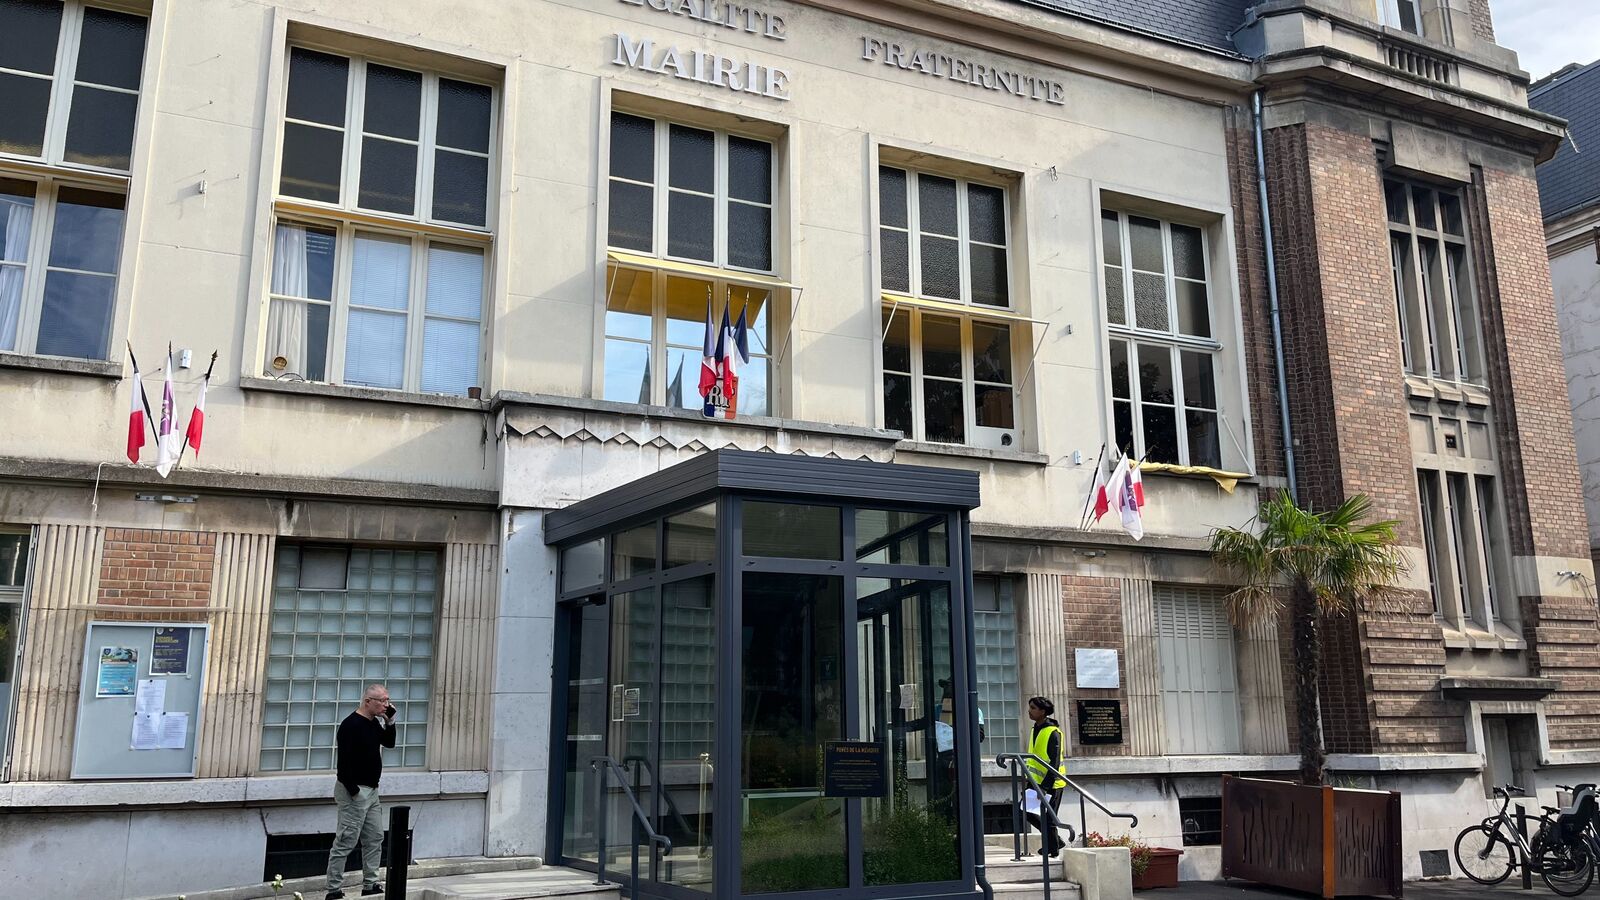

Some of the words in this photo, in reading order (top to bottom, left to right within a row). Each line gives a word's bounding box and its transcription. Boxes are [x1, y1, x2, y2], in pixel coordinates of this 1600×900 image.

[618, 0, 786, 40] GALITE
[612, 31, 791, 101] MAIRIE
[861, 35, 1065, 105] FRATERNITE
